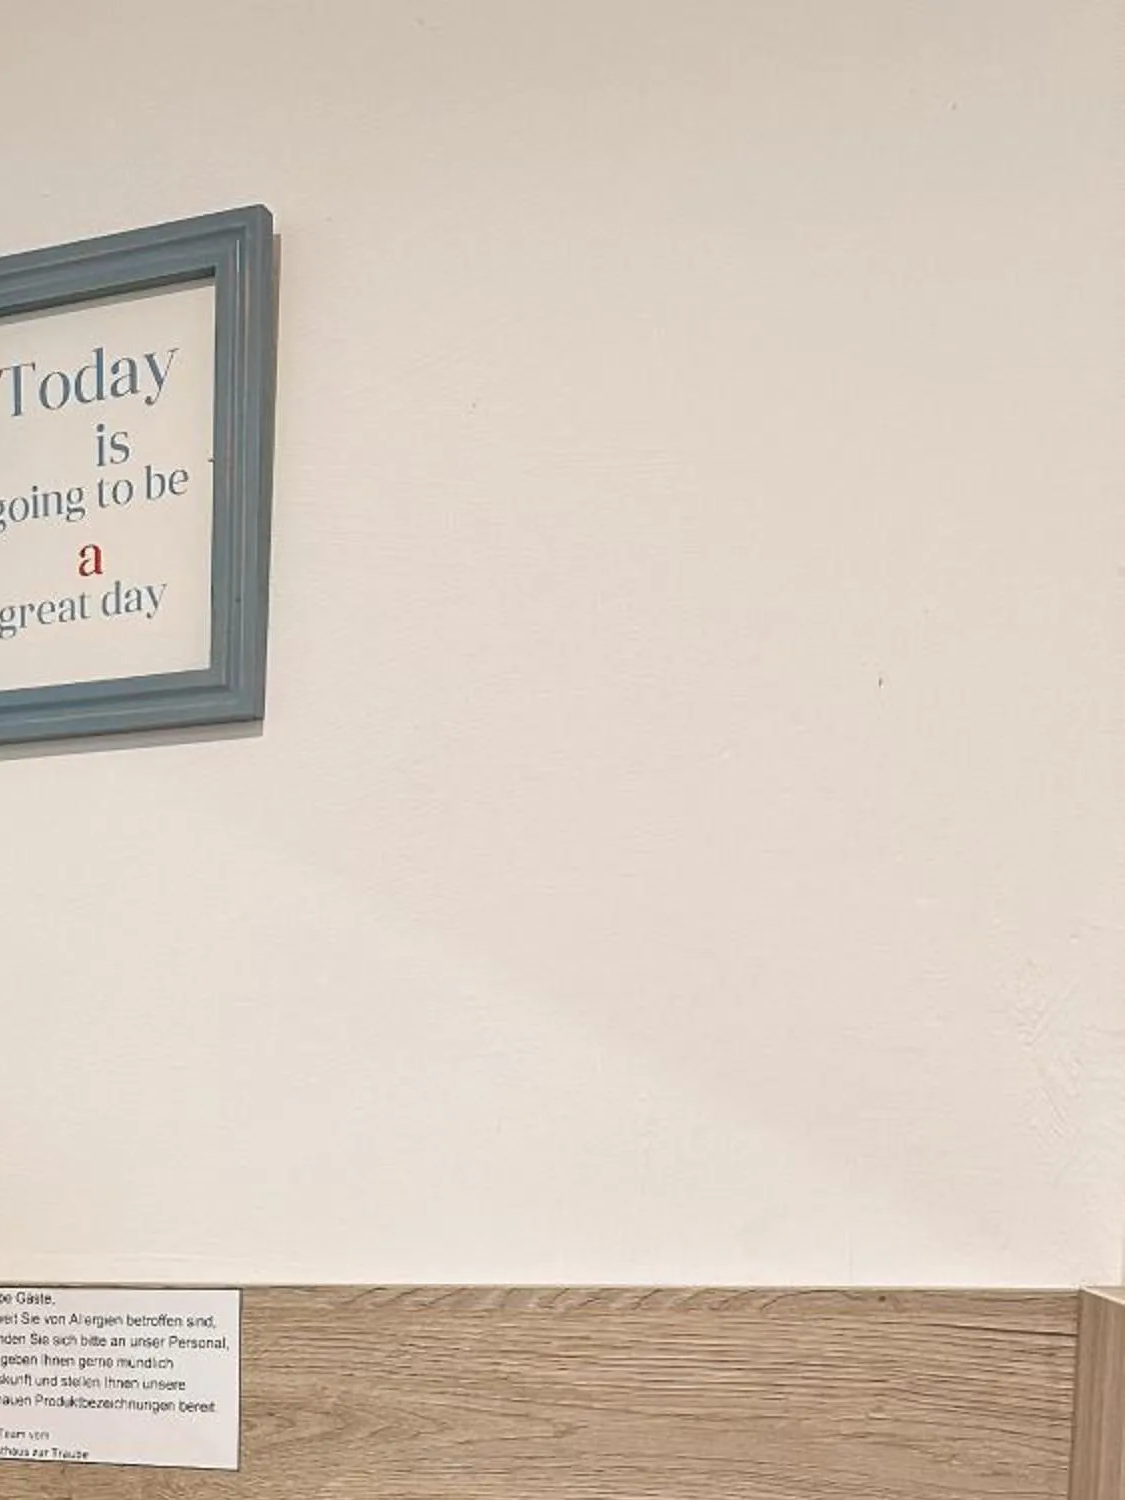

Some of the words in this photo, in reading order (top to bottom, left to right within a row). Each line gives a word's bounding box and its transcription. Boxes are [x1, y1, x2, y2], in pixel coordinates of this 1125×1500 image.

[95, 423, 130, 467] is
[97, 477, 134, 508] to
[145, 466, 190, 501] be
[78, 543, 104, 577] a
[102, 580, 167, 625] day
[21, 1311, 41, 1325] Sie
[44, 1314, 66, 1325] von
[126, 1314, 182, 1327] betroffen
[30, 1333, 50, 1345] Sie
[52, 1334, 78, 1346] sich
[80, 1334, 107, 1347] bitte
[110, 1337, 126, 1347] an
[130, 1337, 165, 1348] unser
[168, 1335, 230, 1351] Personal,
[0, 1354, 38, 1368] geben
[41, 1354, 75, 1367] Ihnen
[78, 1356, 113, 1370] gerne
[35, 1375, 58, 1387] und
[104, 1376, 139, 1389] Ihnen
[142, 1379, 186, 1391] unsere
